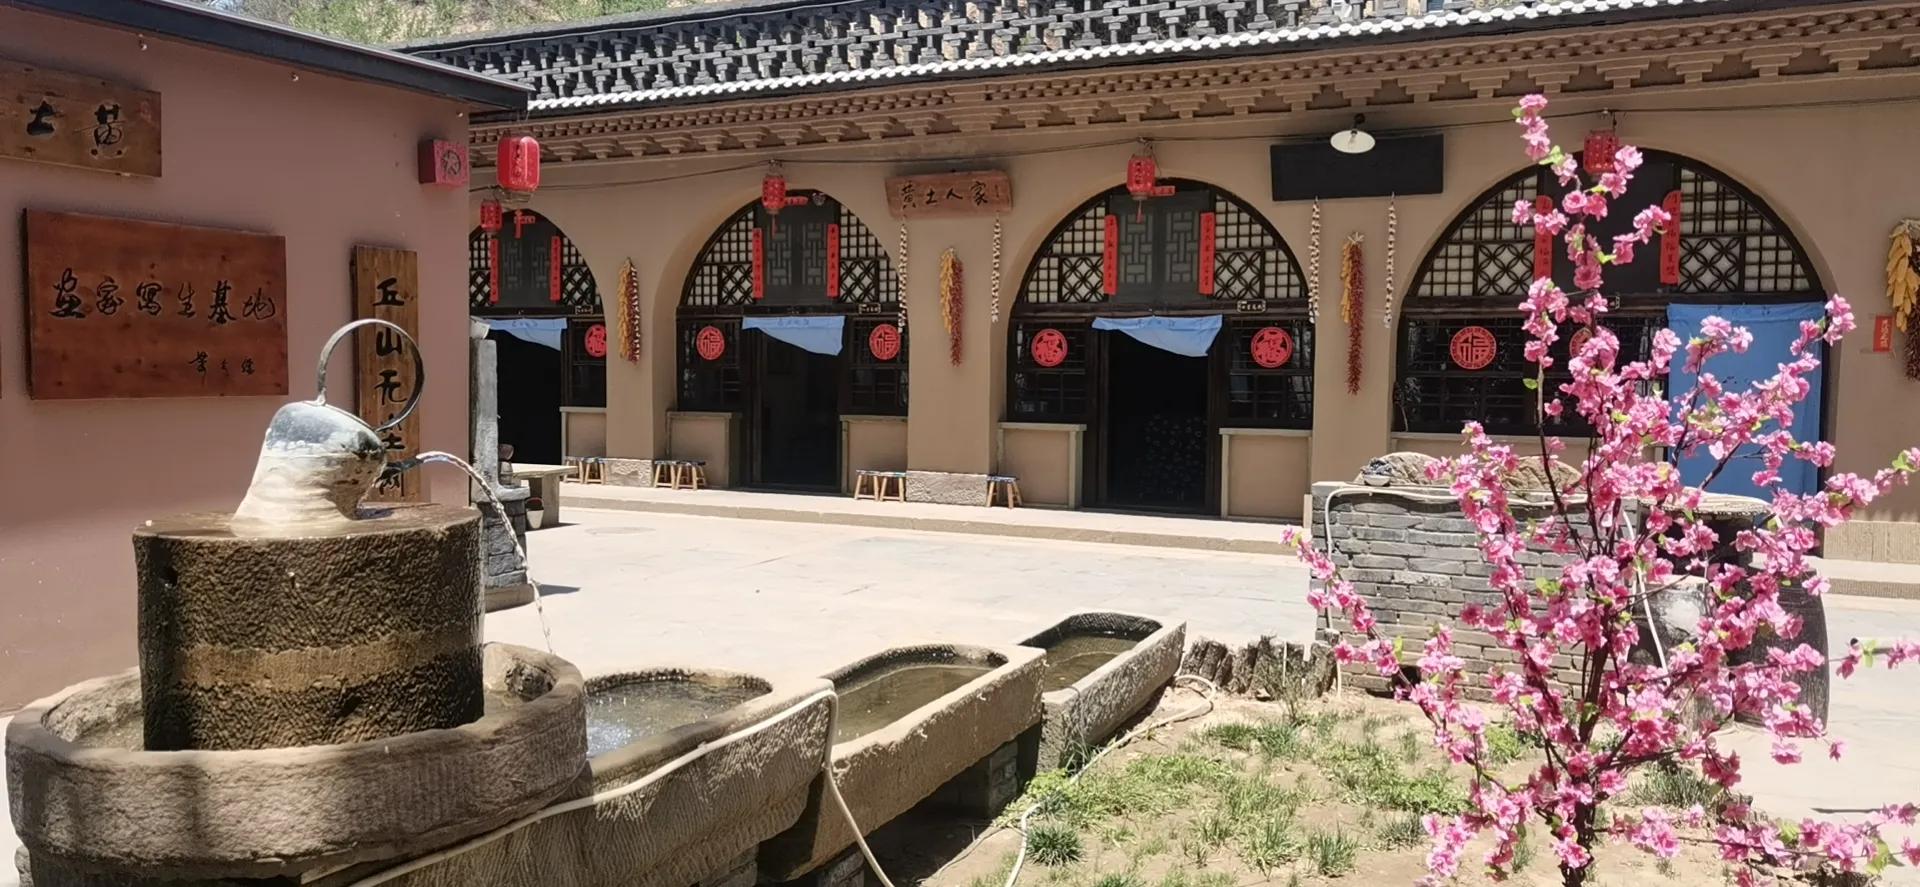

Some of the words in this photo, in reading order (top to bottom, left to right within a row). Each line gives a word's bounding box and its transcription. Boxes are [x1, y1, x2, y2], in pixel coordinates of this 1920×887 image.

[901, 180, 989, 210] 黄土人家
[699, 329, 723, 357] 福
[872, 328, 897, 356] 福
[1454, 330, 1493, 366] 福
